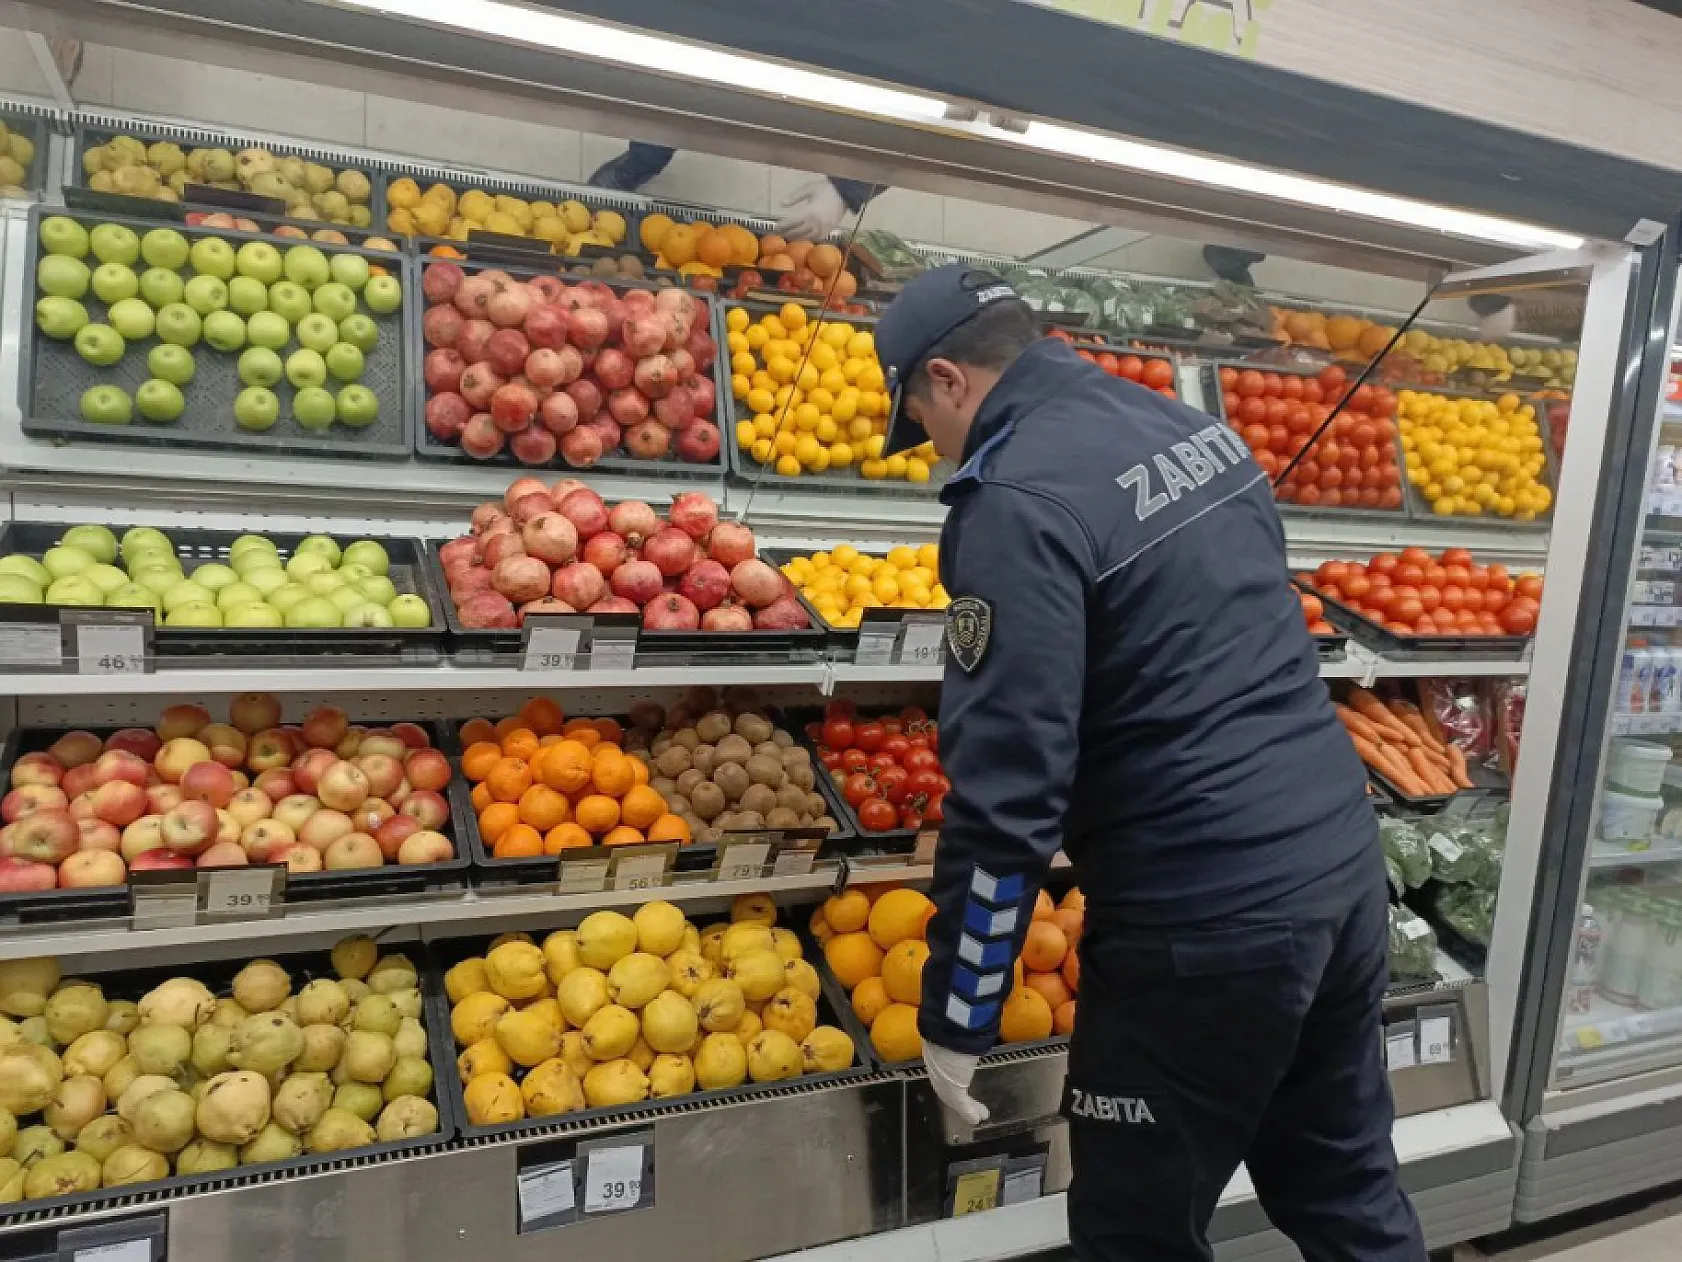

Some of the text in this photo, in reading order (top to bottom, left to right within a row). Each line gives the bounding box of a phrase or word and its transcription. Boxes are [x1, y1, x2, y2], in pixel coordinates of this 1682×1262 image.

[226, 893, 252, 906] 39
[1070, 1088, 1157, 1123] ZABITA
[603, 1181, 625, 1199] 39
